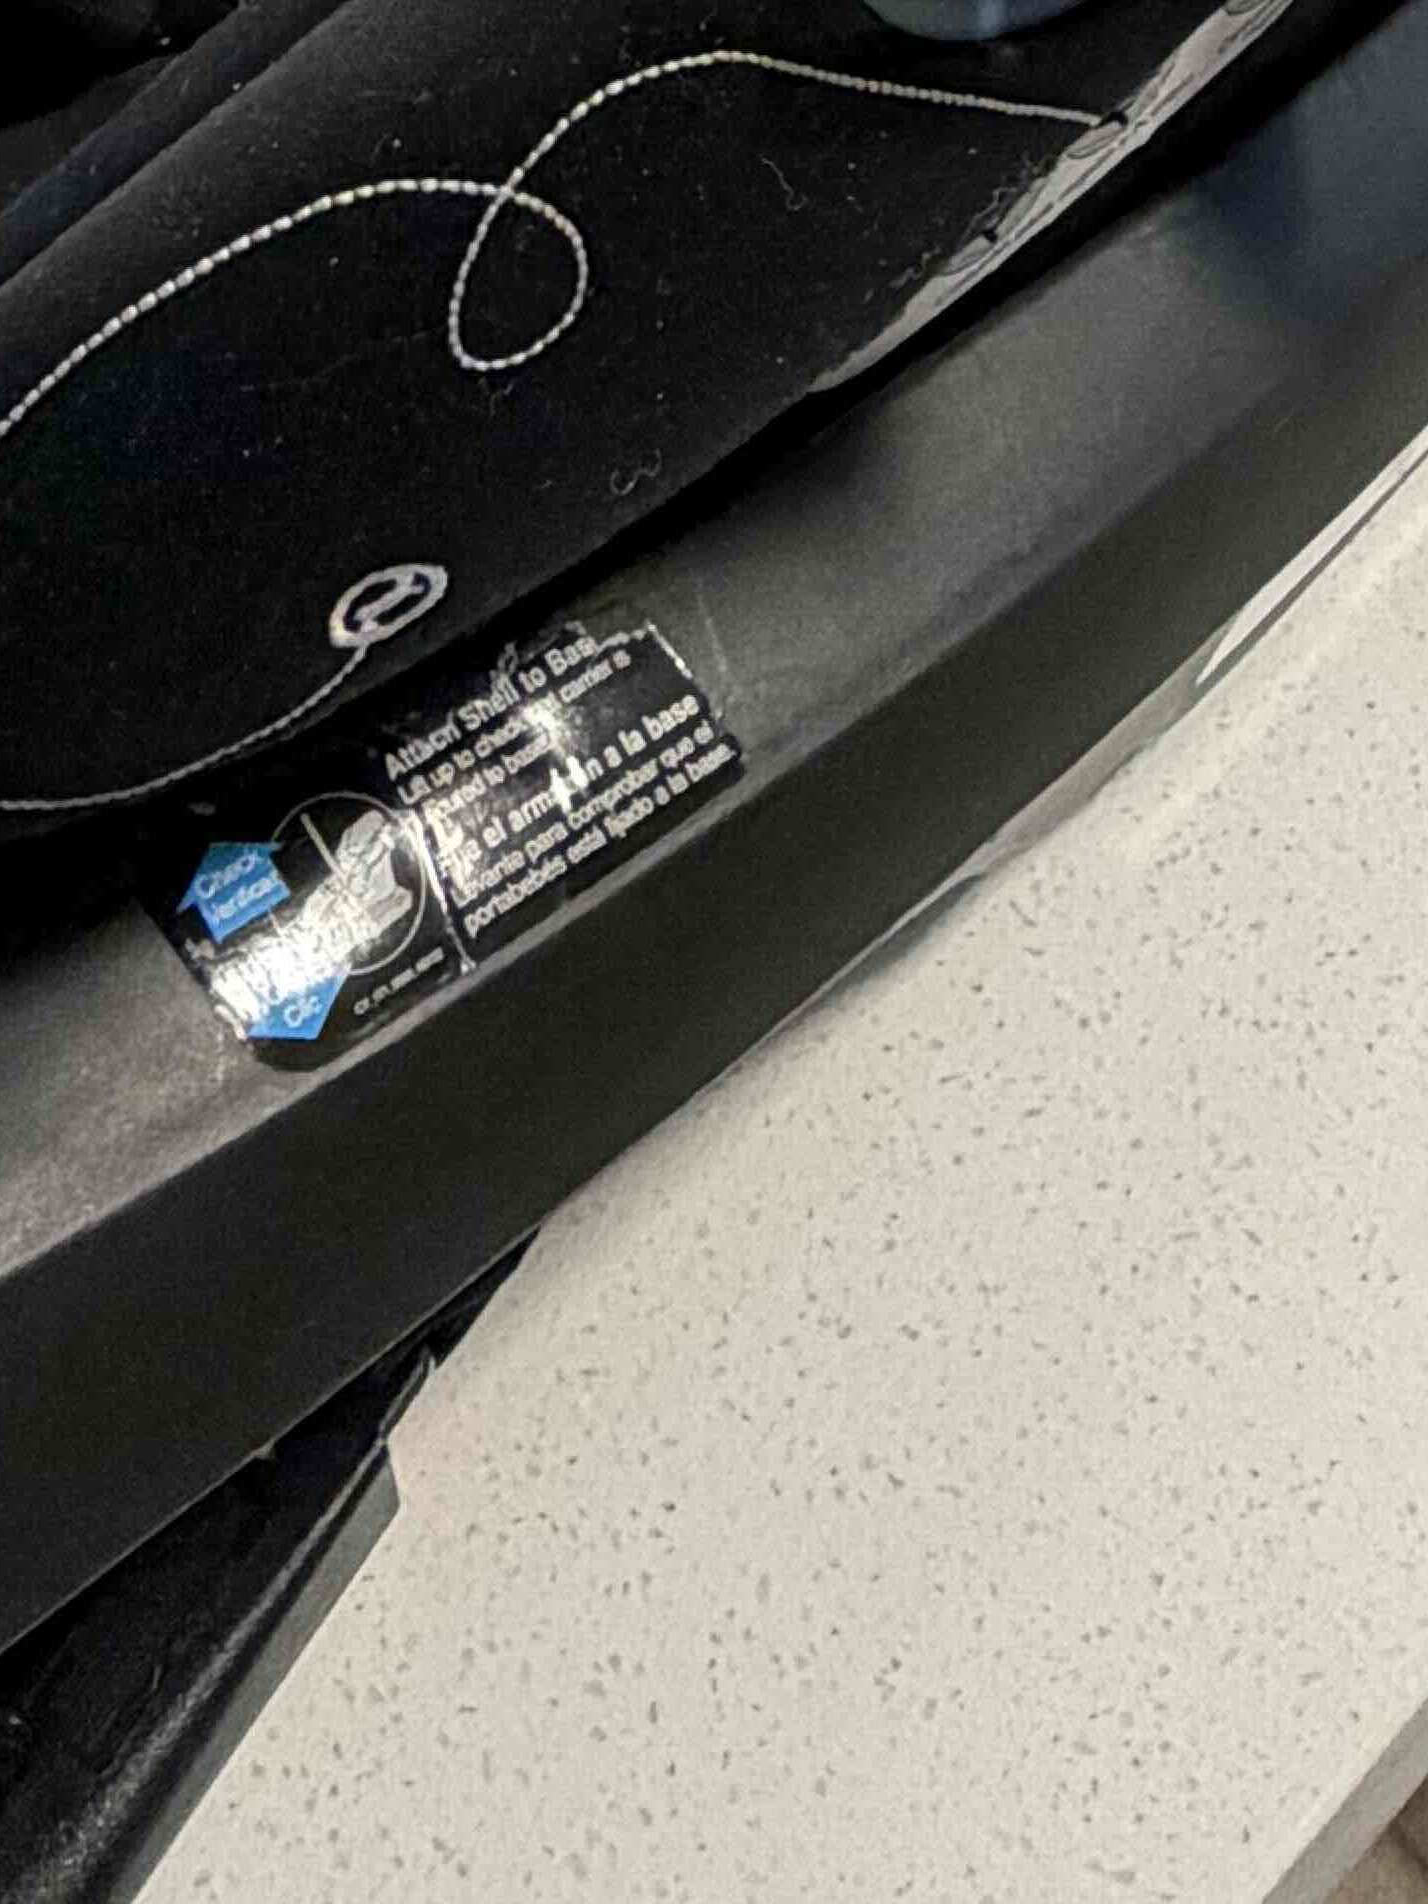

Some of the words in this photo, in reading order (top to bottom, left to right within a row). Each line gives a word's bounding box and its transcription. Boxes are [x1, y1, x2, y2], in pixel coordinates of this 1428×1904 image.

[518, 667, 546, 692] to
[618, 730, 645, 755] la
[642, 695, 698, 739] base
